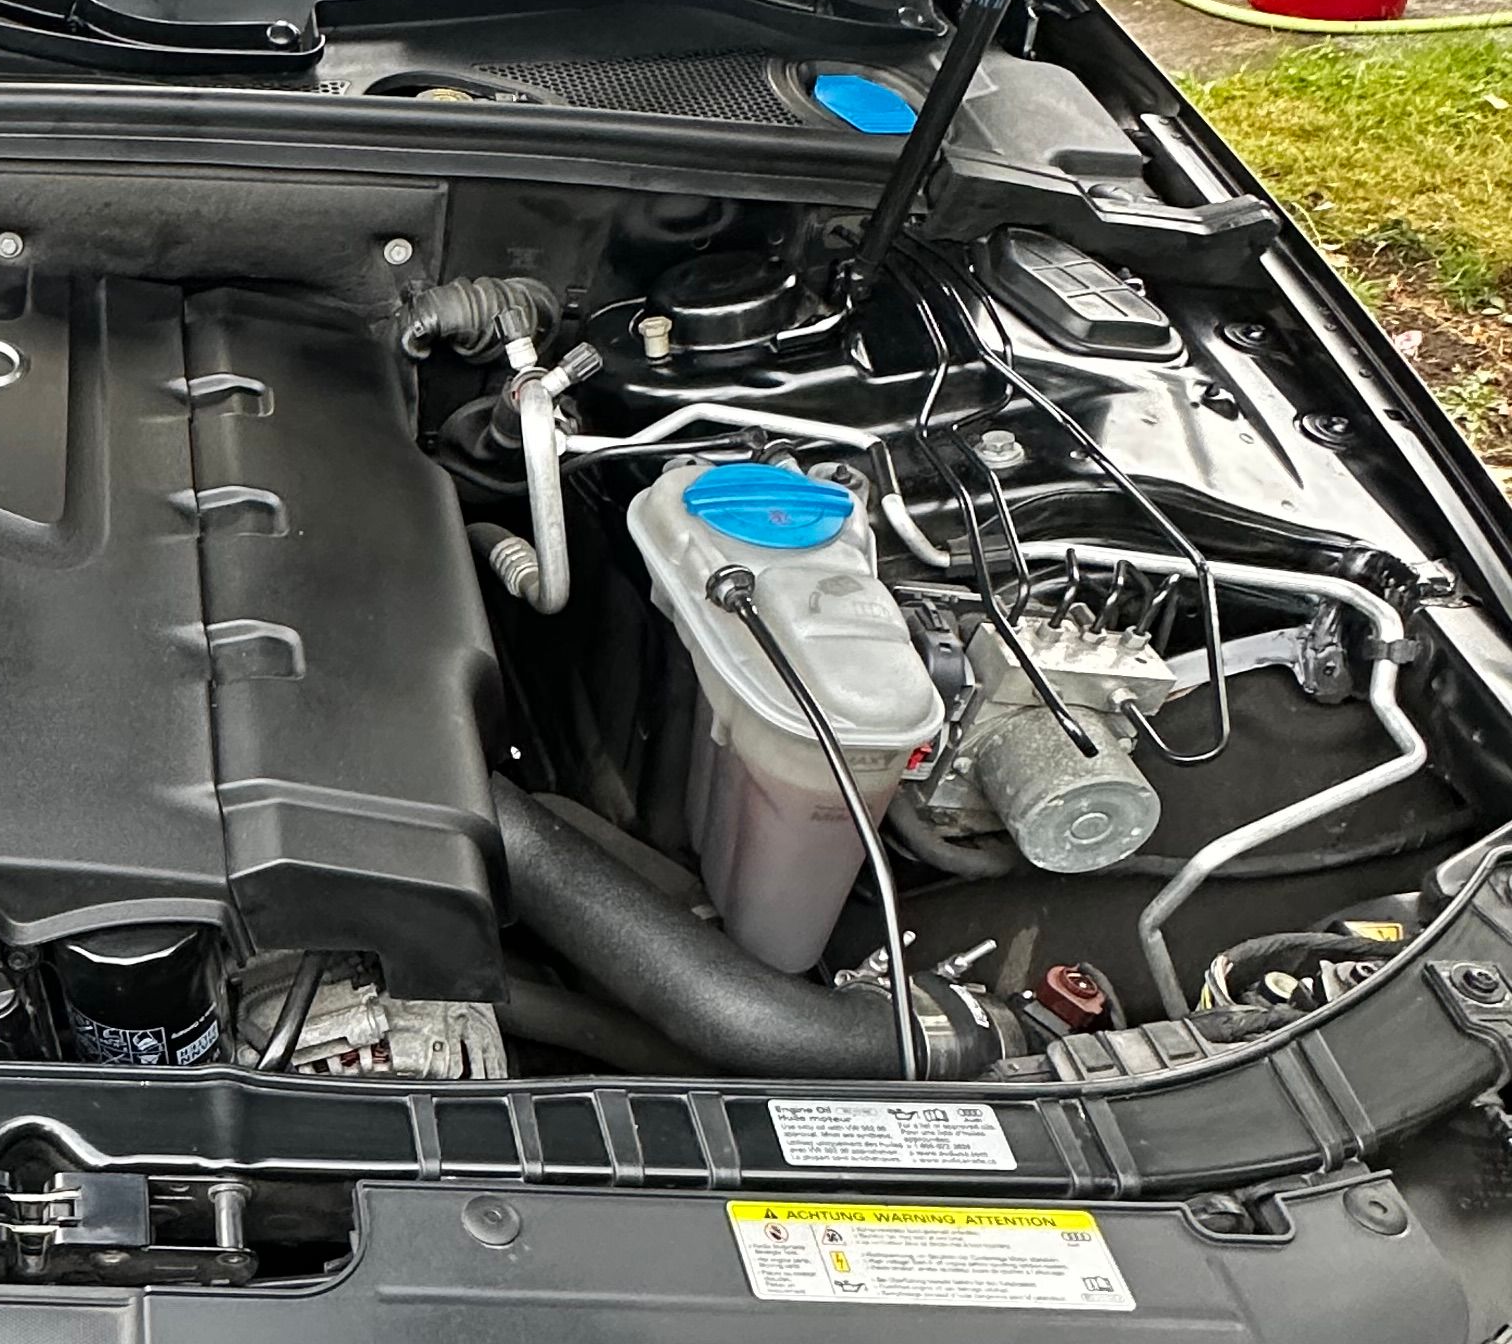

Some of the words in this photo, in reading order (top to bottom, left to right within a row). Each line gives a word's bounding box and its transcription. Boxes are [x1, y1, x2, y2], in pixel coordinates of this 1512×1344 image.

[786, 1209, 866, 1222] ACHTUNG
[874, 1212, 956, 1225] WARNING
[966, 1214, 1057, 1228] ATTENTION
